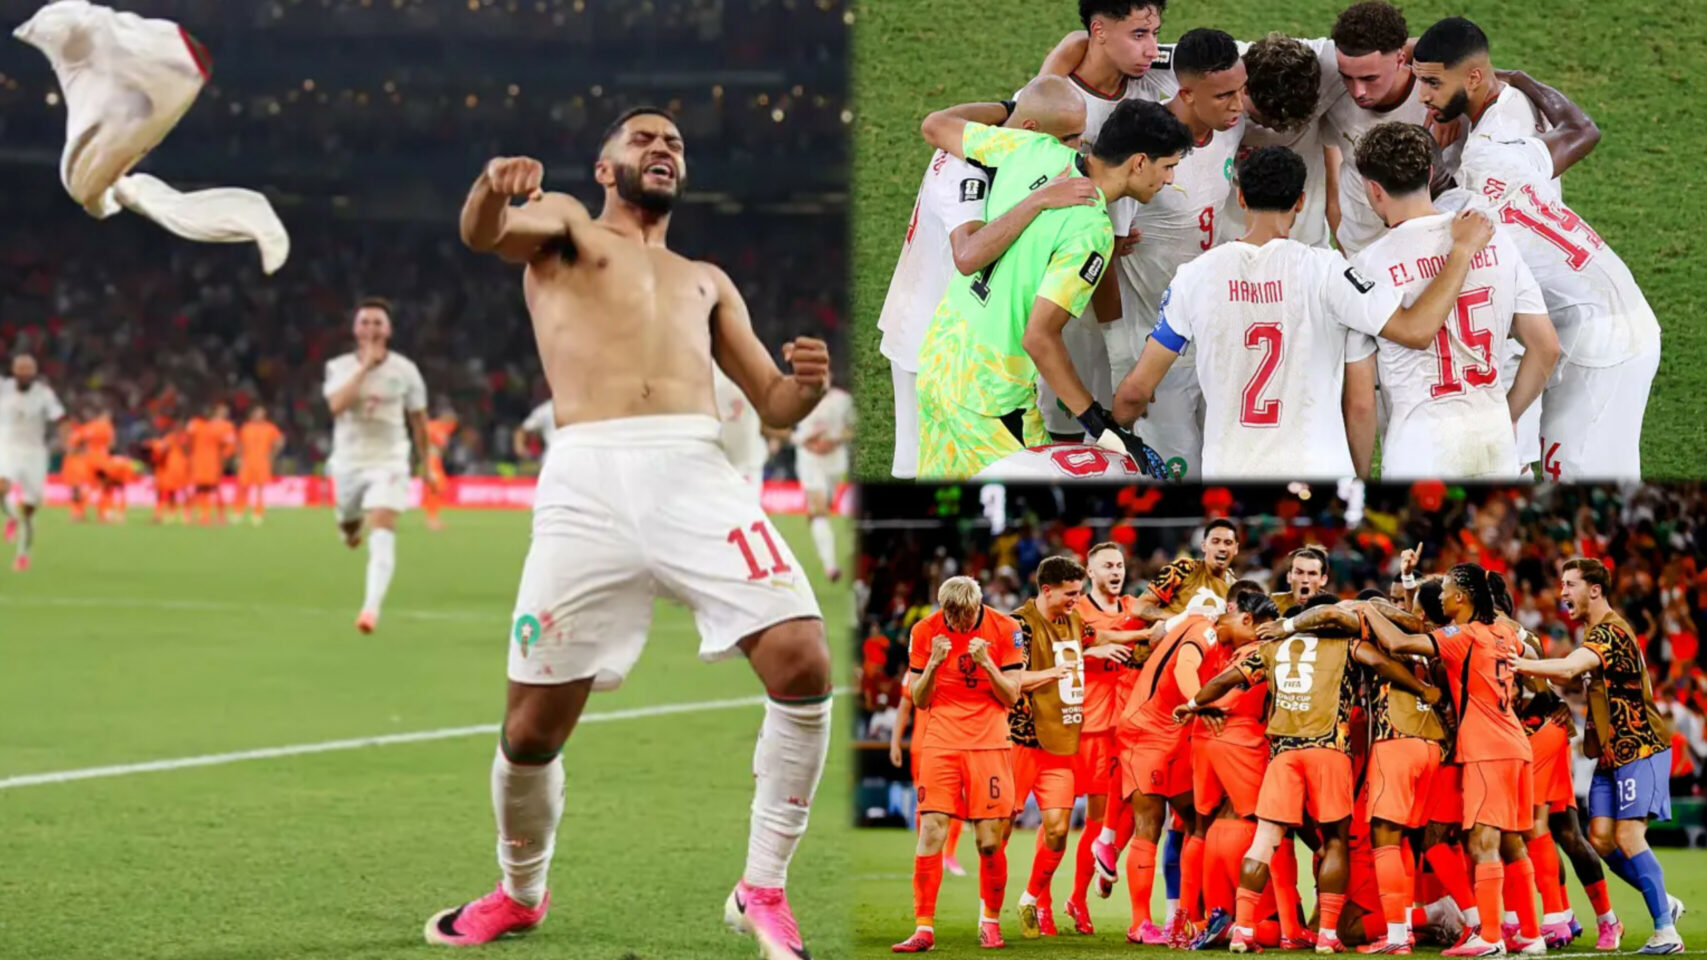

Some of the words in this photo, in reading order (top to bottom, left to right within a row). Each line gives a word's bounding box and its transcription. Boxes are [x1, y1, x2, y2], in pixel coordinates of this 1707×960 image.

[1198, 205, 1215, 251] 9
[1388, 263, 1415, 287] EL
[1416, 245, 1499, 279] MOUBET
[1228, 279, 1284, 304] HAKIMI
[1430, 286, 1498, 400] 15
[1240, 321, 1285, 428] 2
[727, 520, 791, 580] 11
[989, 776, 1001, 799] 6
[1617, 778, 1637, 803] 13
